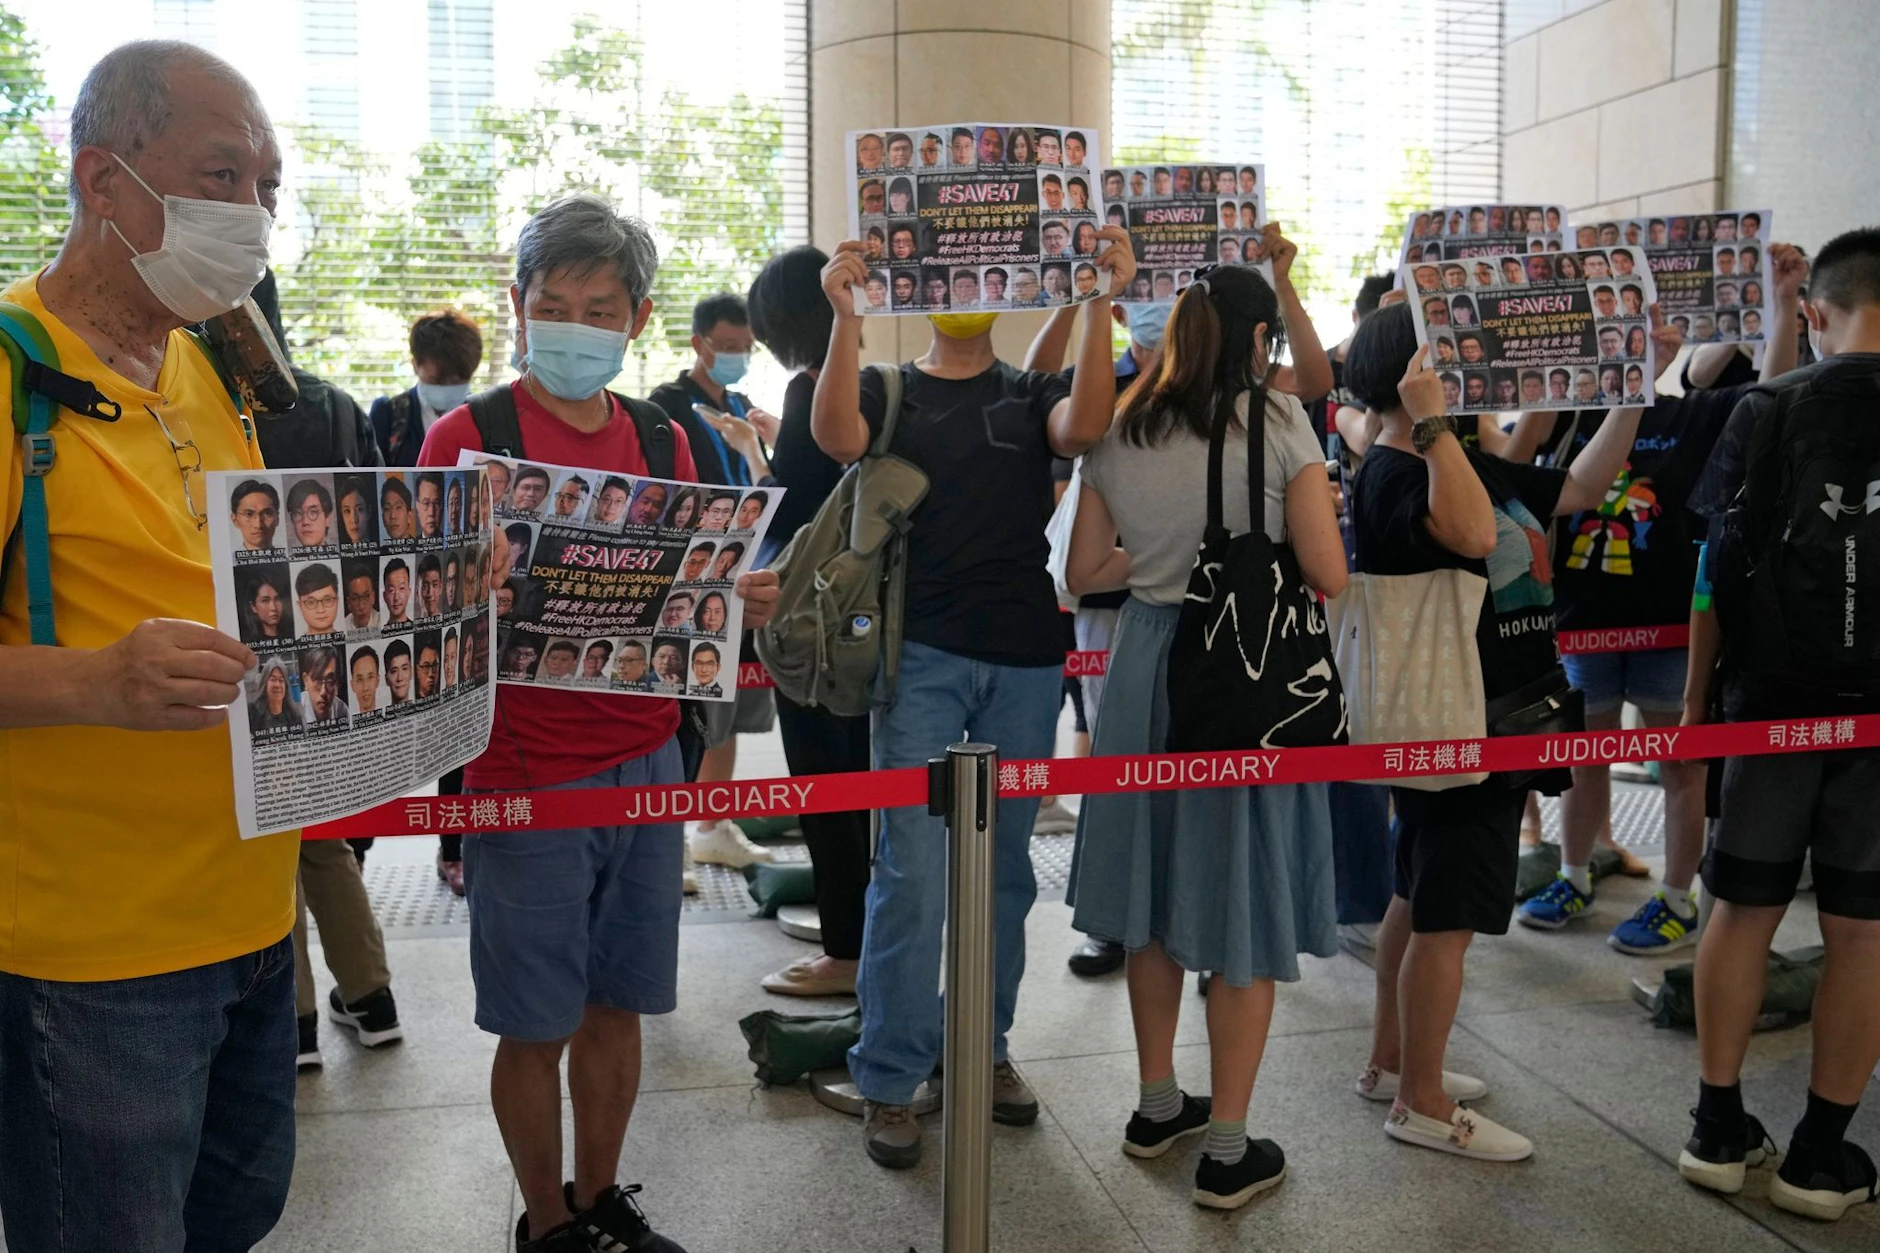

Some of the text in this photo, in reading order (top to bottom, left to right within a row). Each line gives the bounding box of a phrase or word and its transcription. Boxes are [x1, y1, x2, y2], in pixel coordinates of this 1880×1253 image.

[938, 183, 1020, 204] #SAVE47
[920, 208, 948, 217] DON'T
[948, 207, 964, 216] LET
[964, 206, 989, 214] THEM
[990, 204, 1038, 214] DISAPPEAR!
[1145, 207, 1205, 223] #SAVE47
[938, 244, 1020, 254] #FreeHKDemocrats
[921, 254, 1039, 266] #ReleaseAllPoliticalPrisoners
[1498, 295, 1573, 316] #SAVE47
[1483, 312, 1592, 328] DON'T LET THEM DISAPPEAR!
[1505, 348, 1580, 358] #FreeHKDemocrats
[1490, 356, 1598, 368] #ReleaseAllPoliticalPrisoners
[588, 533, 611, 542] Please
[610, 537, 638, 545] continue
[560, 544, 665, 570] #SAVE47
[531, 566, 568, 579] DON'T
[568, 571, 588, 580] LET
[589, 572, 617, 583] THEM
[618, 574, 673, 584] DISAPPEAR!
[543, 581, 659, 598] 不要讓他們被消失!
[1844, 535, 1856, 647] UNDER ARMOUR
[544, 599, 647, 614] #釋放所有政治犯
[541, 612, 638, 625] #FreeHKDemocrats
[514, 621, 654, 636] #ReleaseAllPoliticalPrisoners
[1565, 629, 1660, 650] JUDICIARY
[275, 645, 298, 654] Gwyneth
[1768, 719, 1856, 747] 司法機構
[1538, 733, 1680, 763] JUDICIARY
[1383, 743, 1482, 771] 司法機構
[1116, 755, 1280, 786] JUDICIARY
[626, 782, 814, 818] JUDICIARY
[405, 797, 533, 829] 司法機構
